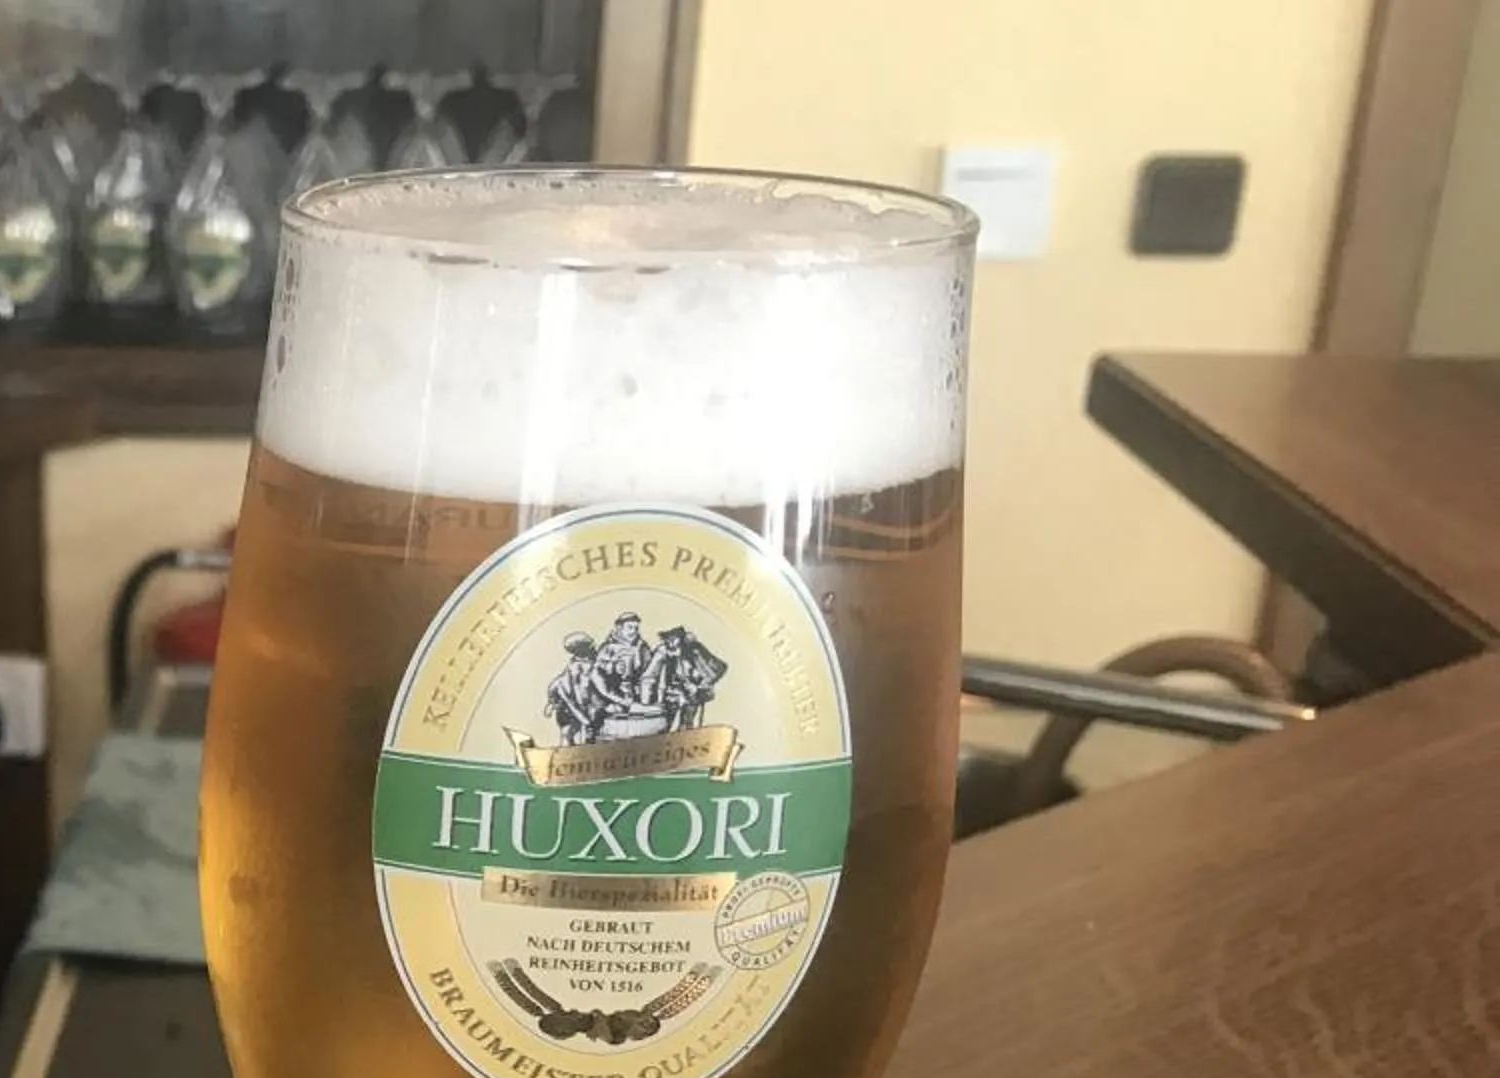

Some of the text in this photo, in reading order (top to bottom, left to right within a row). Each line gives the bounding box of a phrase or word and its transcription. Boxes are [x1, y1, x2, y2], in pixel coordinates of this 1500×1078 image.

[431, 785, 792, 862] HUXORI
[500, 874, 540, 898] Die
[569, 918, 655, 935] GEBRAUT
[527, 935, 691, 954] NACH DEUTSCHEM
[529, 955, 687, 974] REINHEITSGEBOT
[569, 978, 644, 993] VON 1516
